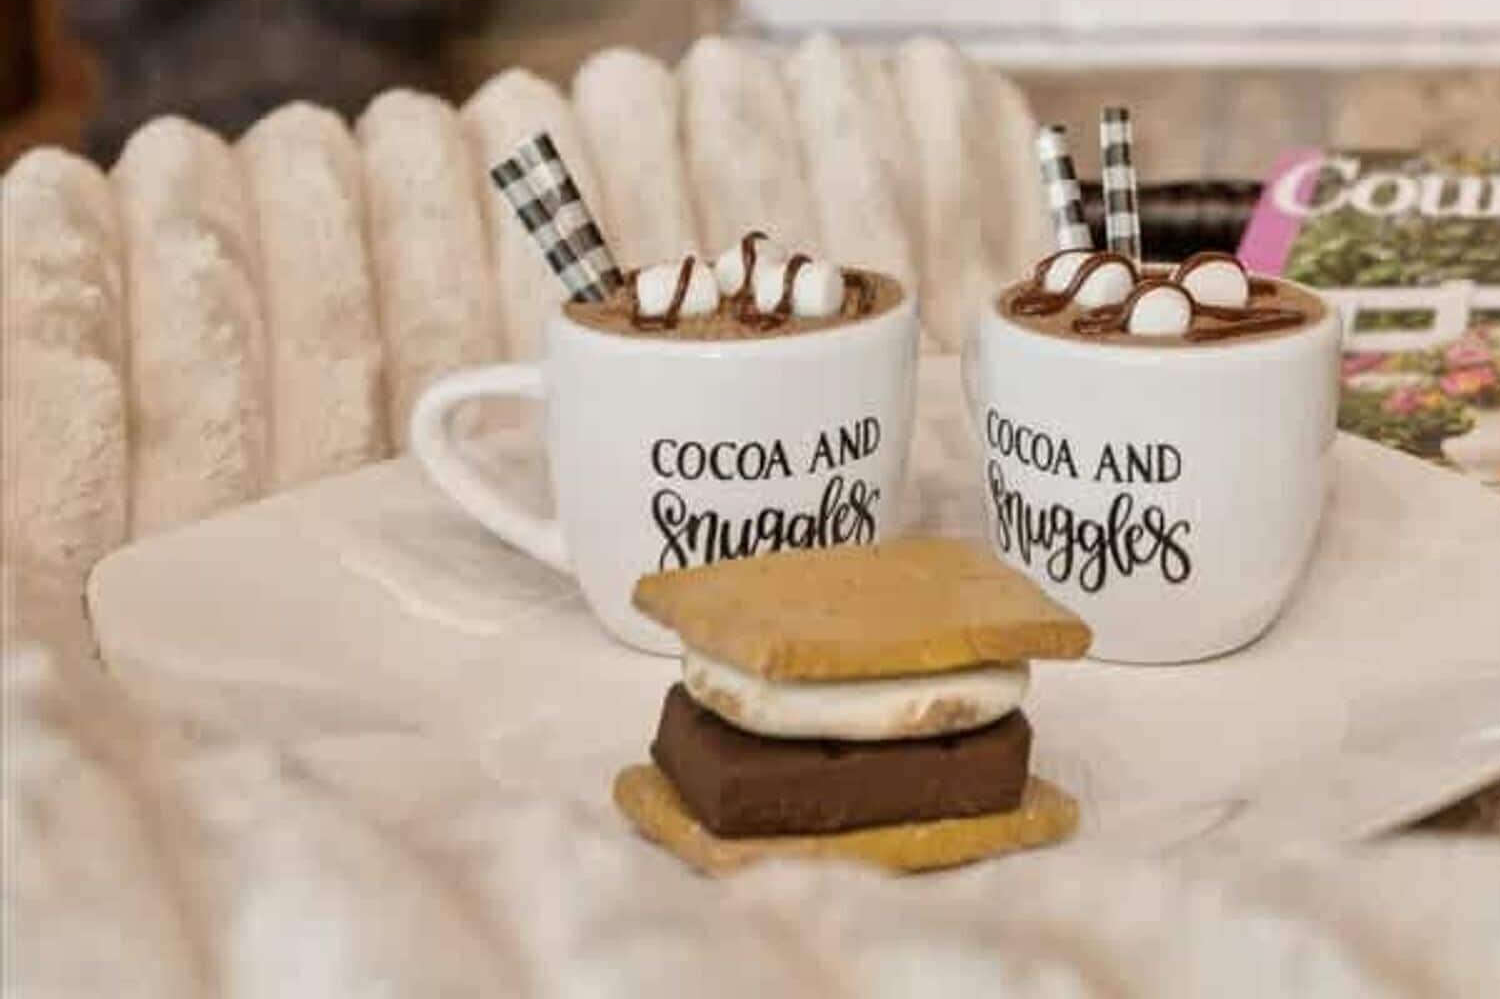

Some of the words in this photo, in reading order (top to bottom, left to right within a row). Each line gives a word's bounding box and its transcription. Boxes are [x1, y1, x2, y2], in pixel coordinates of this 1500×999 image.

[652, 438, 791, 481] COCOA
[809, 415, 881, 474] AND
[987, 408, 1077, 480] COCOA
[1093, 444, 1182, 484] AND
[988, 460, 1192, 593] Snuggles
